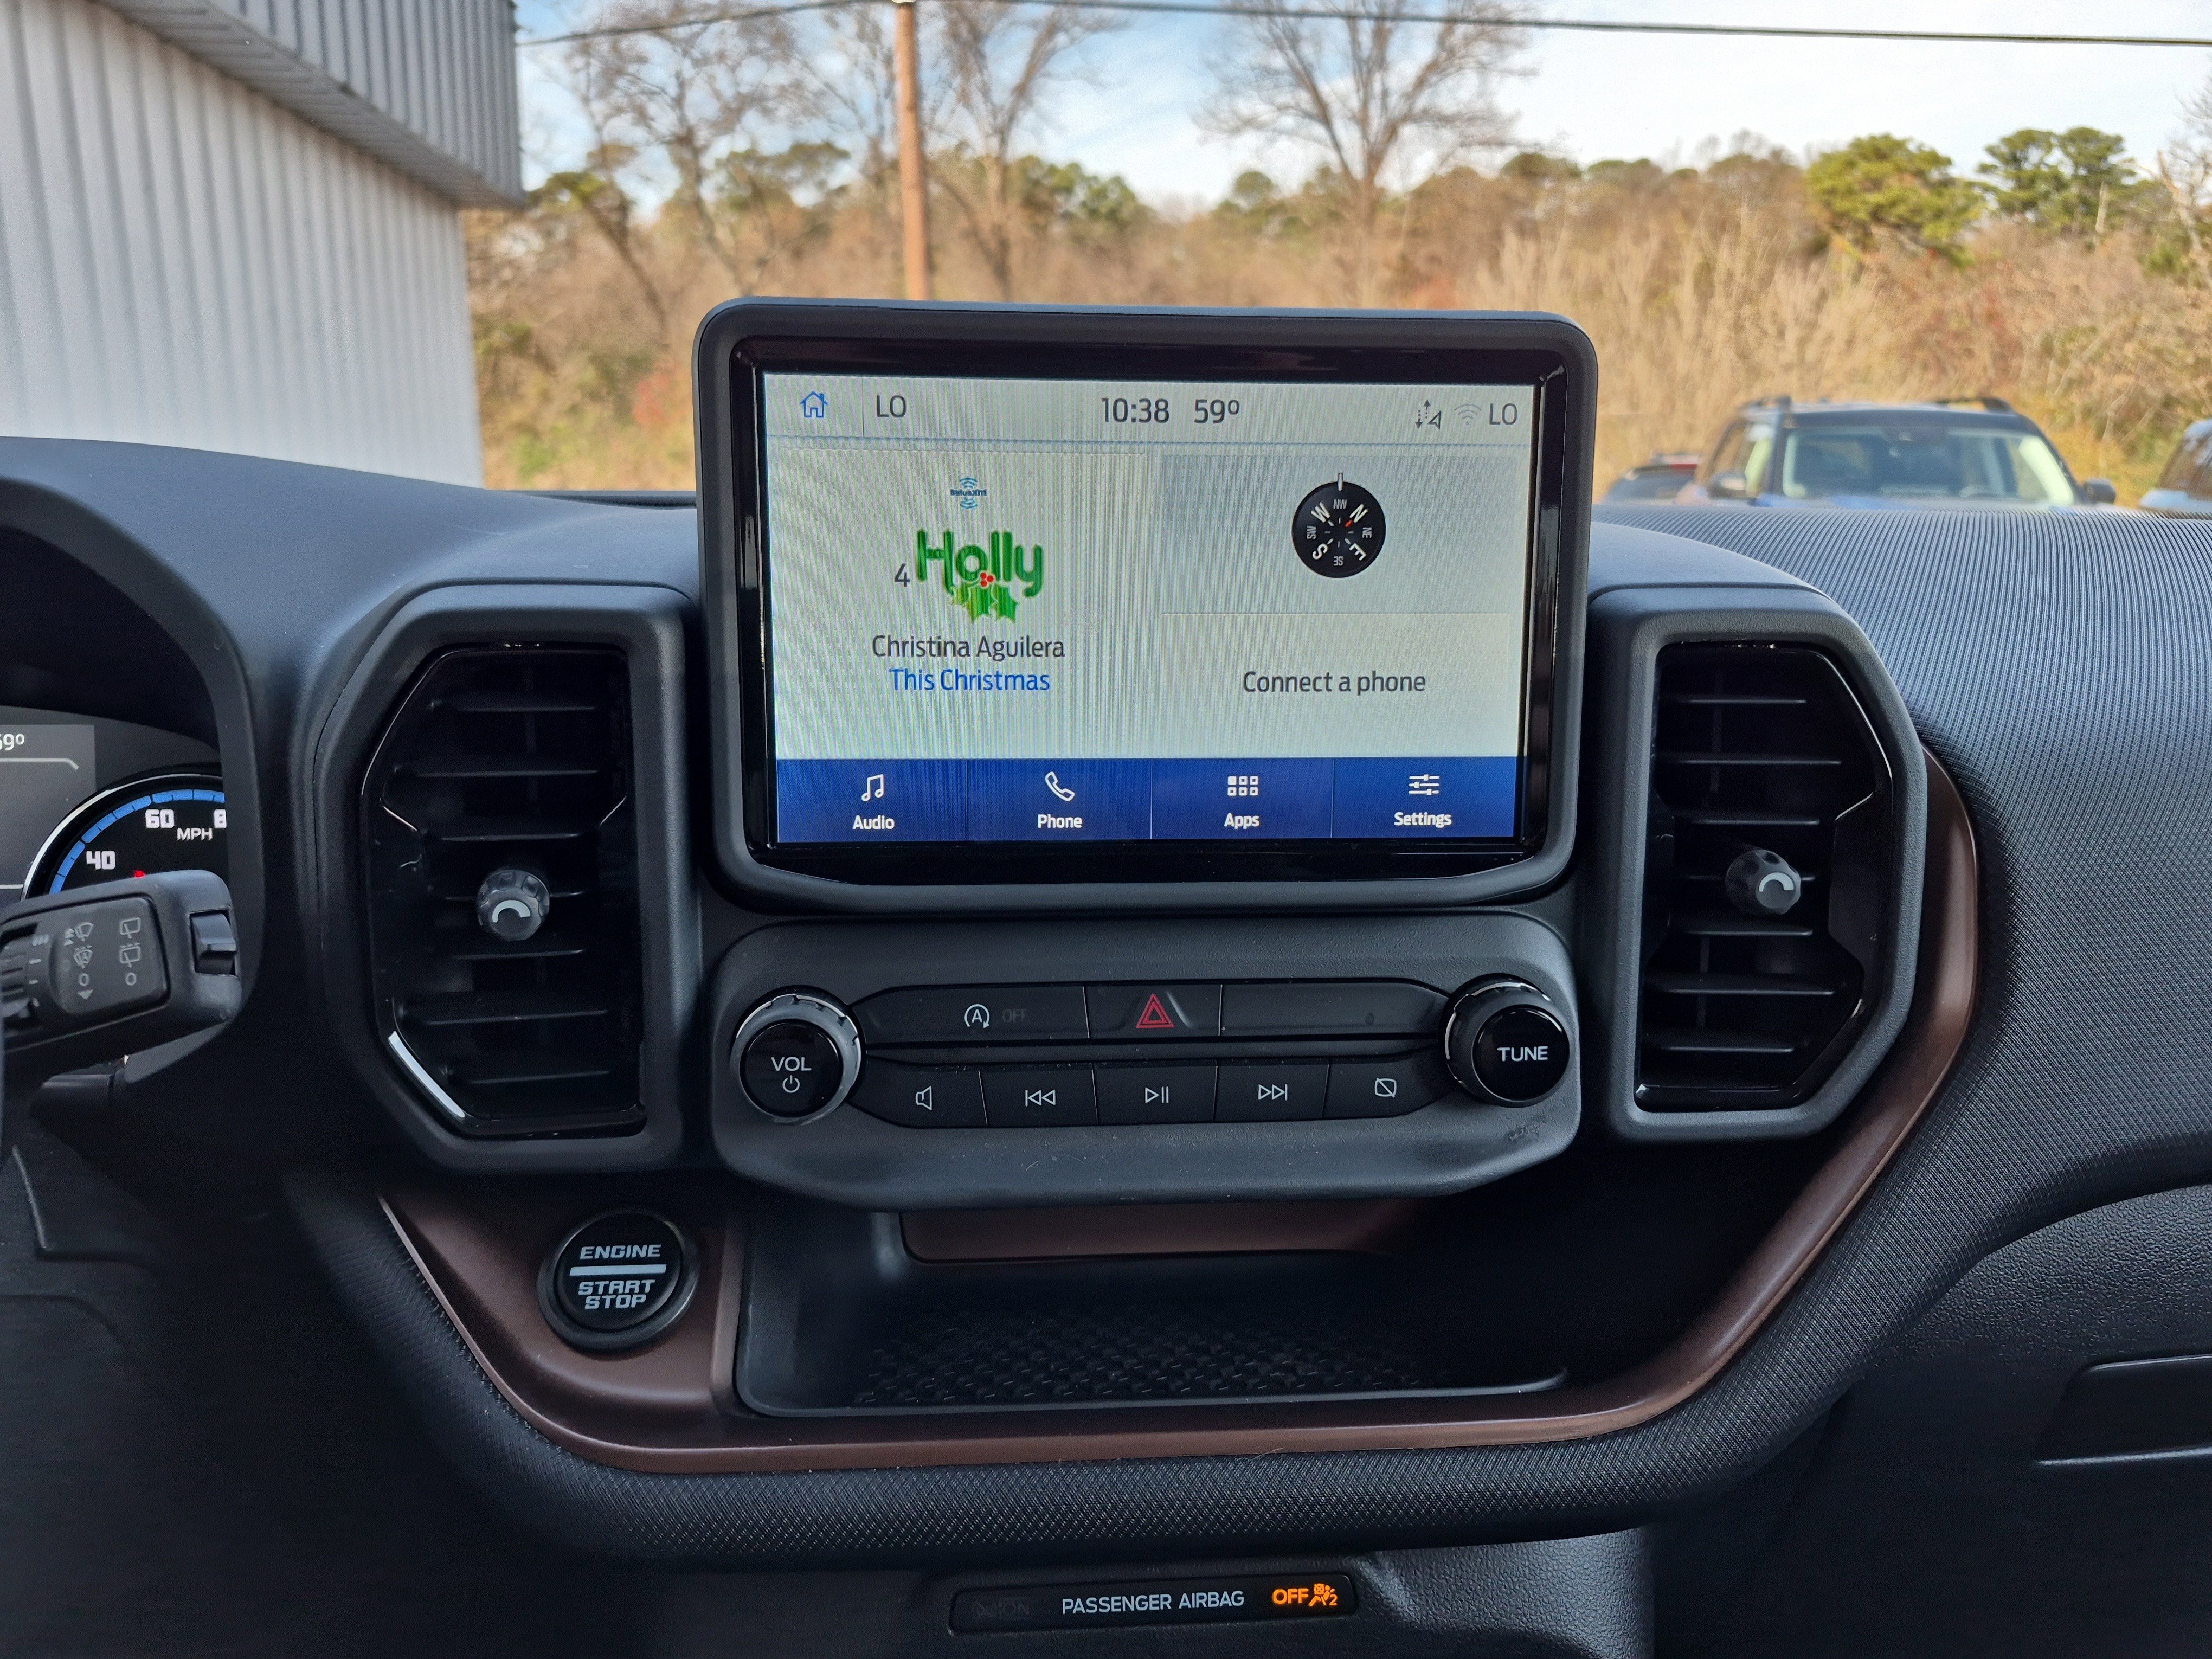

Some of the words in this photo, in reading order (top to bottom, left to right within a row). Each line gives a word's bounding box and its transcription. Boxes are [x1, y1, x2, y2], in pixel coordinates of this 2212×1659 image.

[876, 395, 906, 418] LO
[1102, 398, 1169, 423] 10:38
[1489, 403, 1517, 425] LO
[1310, 501, 1331, 523] W
[1333, 499, 1347, 509] NW
[1349, 503, 1368, 523] N
[1362, 526, 1372, 539] NE
[1312, 543, 1329, 560] S
[1349, 543, 1367, 561] E
[894, 563, 910, 587] 4
[917, 530, 1043, 597] Holly
[872, 635, 970, 657] Christina
[976, 636, 1065, 662] Aguilera
[889, 668, 935, 690] This
[940, 669, 1051, 691] Christmas
[1243, 671, 1333, 692] Connect
[1338, 676, 1351, 692] a
[1357, 671, 1426, 696] phone
[145, 809, 175, 829] 60
[852, 815, 895, 829] Audio
[1038, 814, 1083, 828] Phone
[1224, 813, 1260, 829] Apps
[1394, 812, 1452, 828] Settings
[177, 827, 213, 841] MPH
[86, 850, 116, 870] 40
[1497, 1046, 1548, 1062] TUNE
[771, 1056, 812, 1072] VOL
[580, 1244, 662, 1260] ENGINE
[578, 1279, 655, 1295] START
[584, 1294, 646, 1310] STOP
[1062, 1594, 1172, 1615] PASSENGER
[1179, 1590, 1244, 1609] AIRBAG
[1272, 1588, 1309, 1604] OFF
